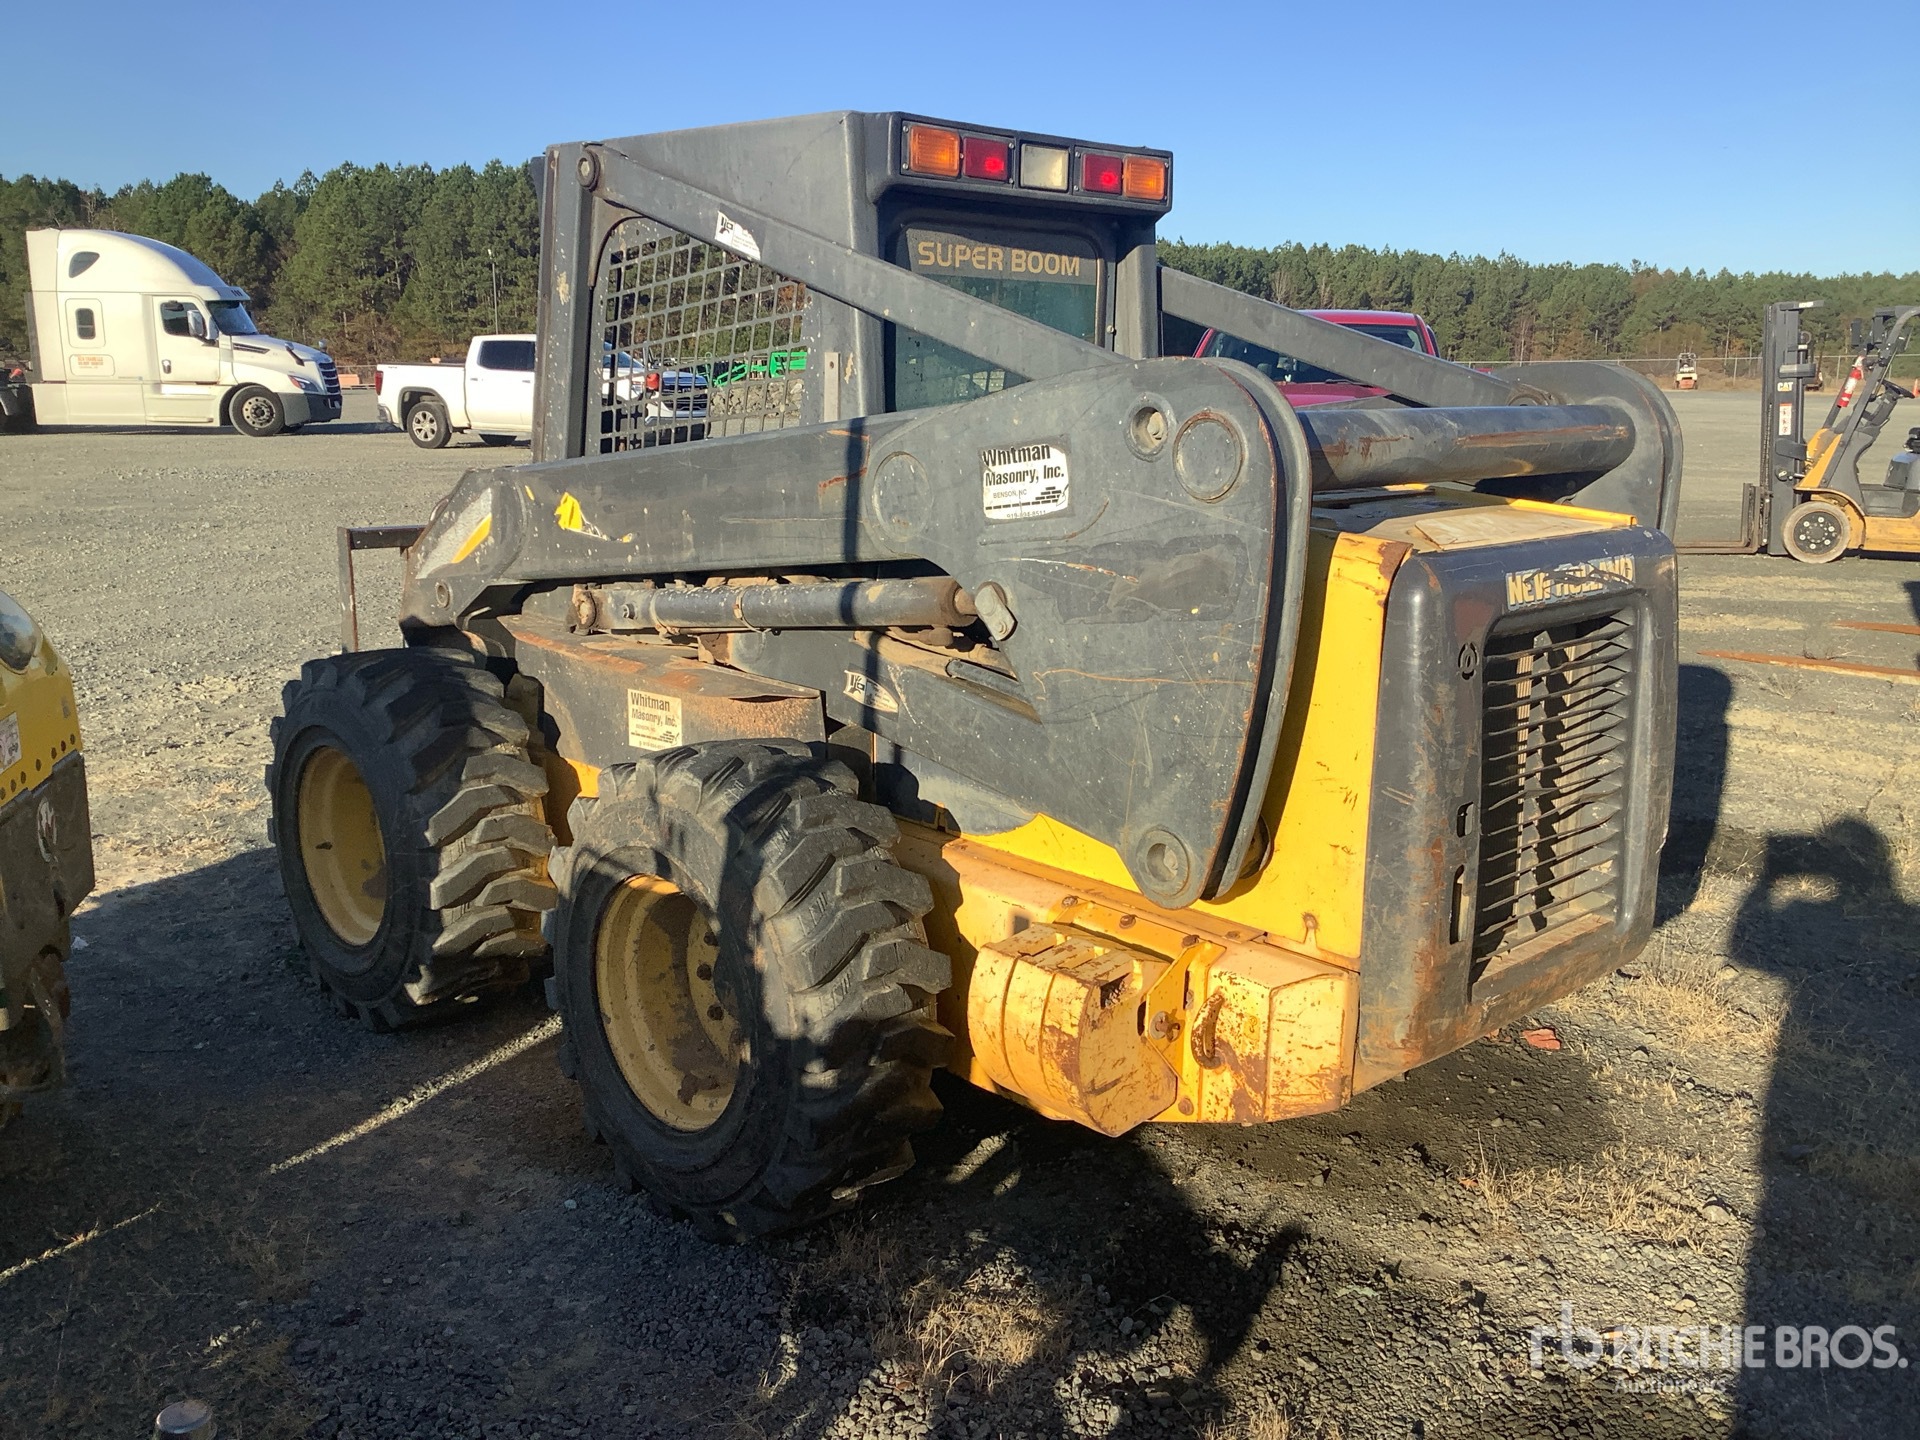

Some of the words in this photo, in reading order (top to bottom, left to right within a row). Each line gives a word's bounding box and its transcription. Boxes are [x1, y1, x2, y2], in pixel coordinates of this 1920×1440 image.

[918, 241, 1003, 271] SUPER
[1011, 249, 1080, 277] BOOM
[1777, 381, 1793, 392] CAT
[985, 469, 1040, 487] Masonry,
[1043, 465, 1065, 479] Inc.
[1507, 571, 1551, 606] NEW
[630, 691, 671, 712] Whitman
[631, 708, 663, 727] Masonry,
[665, 715, 678, 728] Inc.
